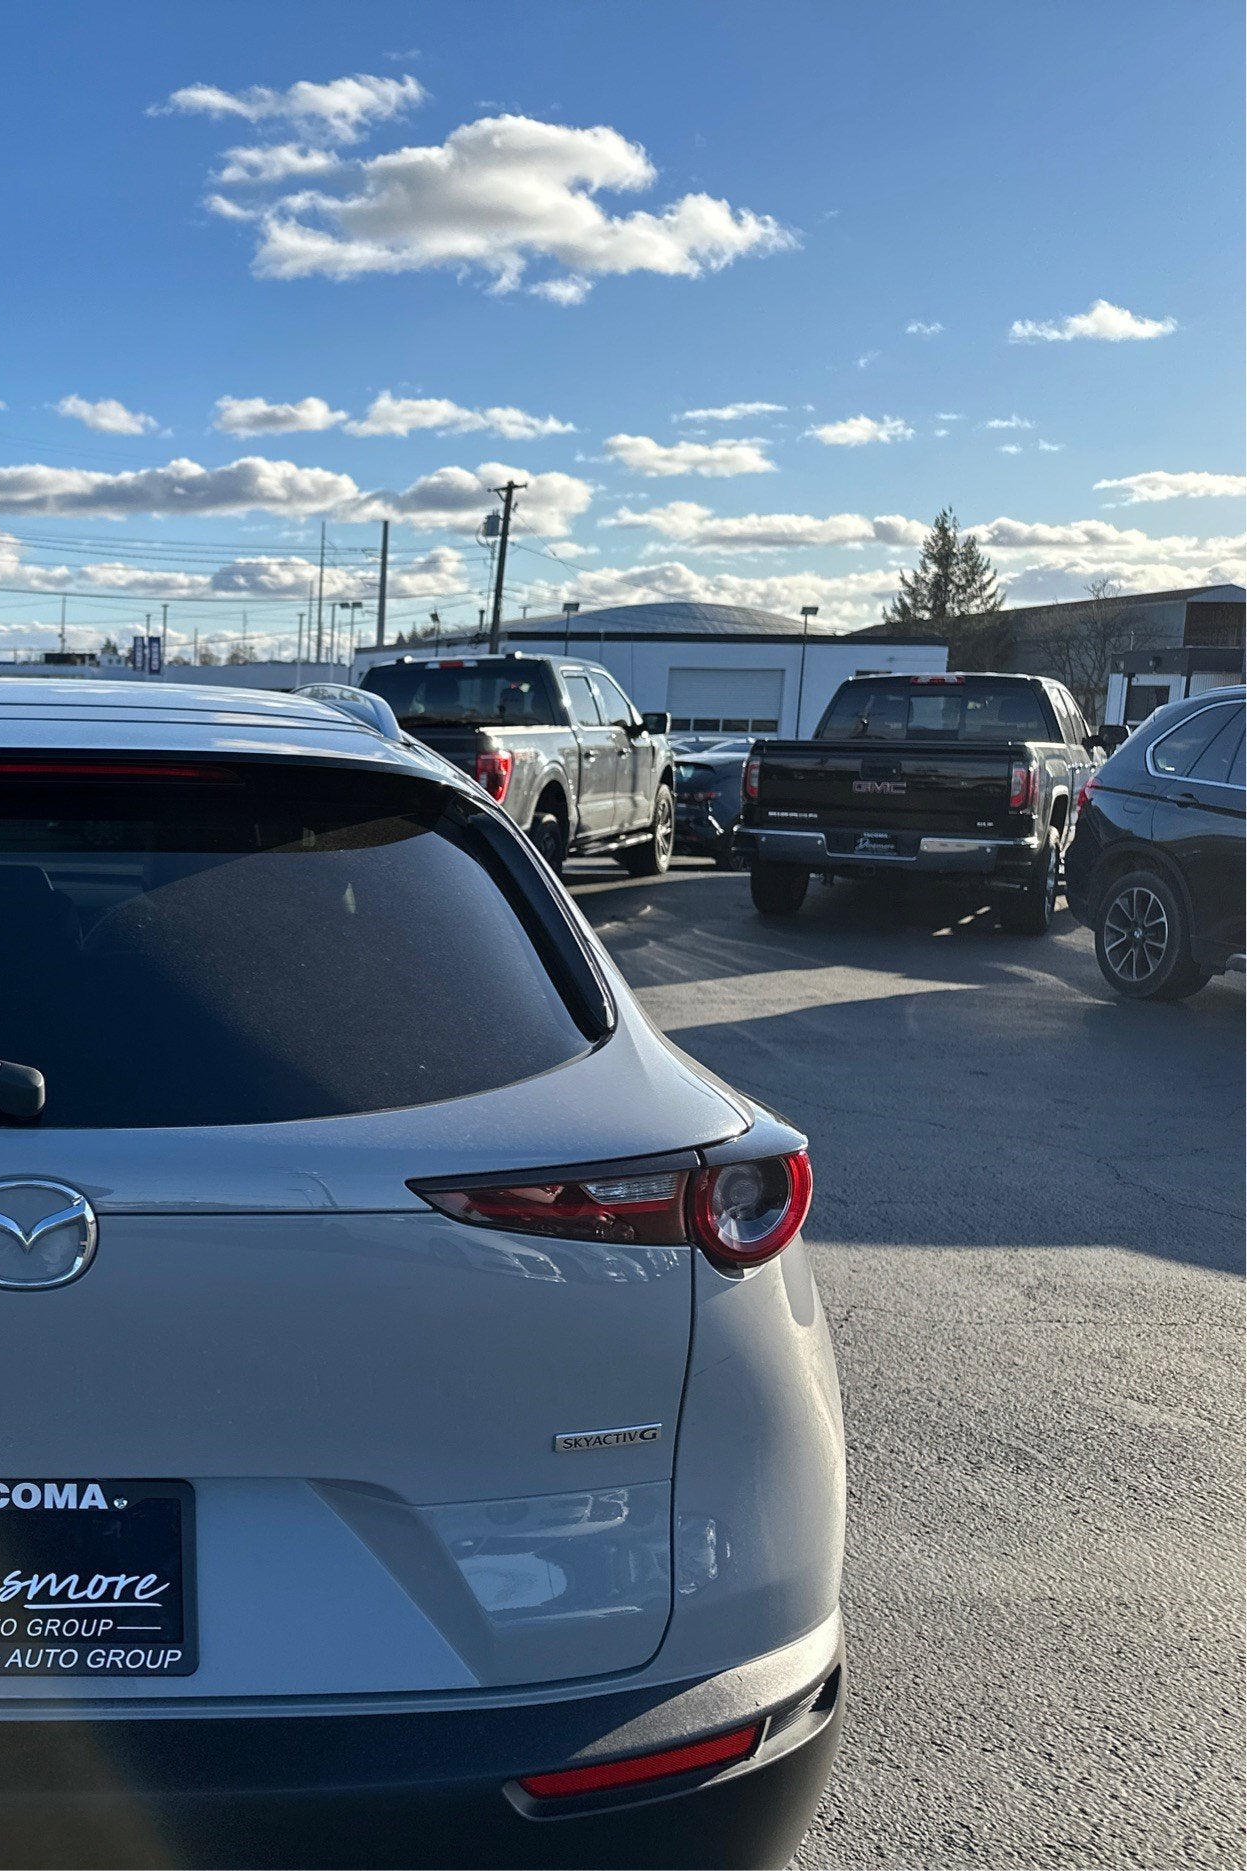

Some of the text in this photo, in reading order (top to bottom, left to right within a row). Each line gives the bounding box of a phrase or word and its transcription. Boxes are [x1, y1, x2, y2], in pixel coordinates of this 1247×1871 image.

[852, 781, 907, 794] GMC
[26, 1618, 114, 1637] GROUP
[4, 1648, 78, 1670] AUTO
[86, 1648, 183, 1670] GROUP
